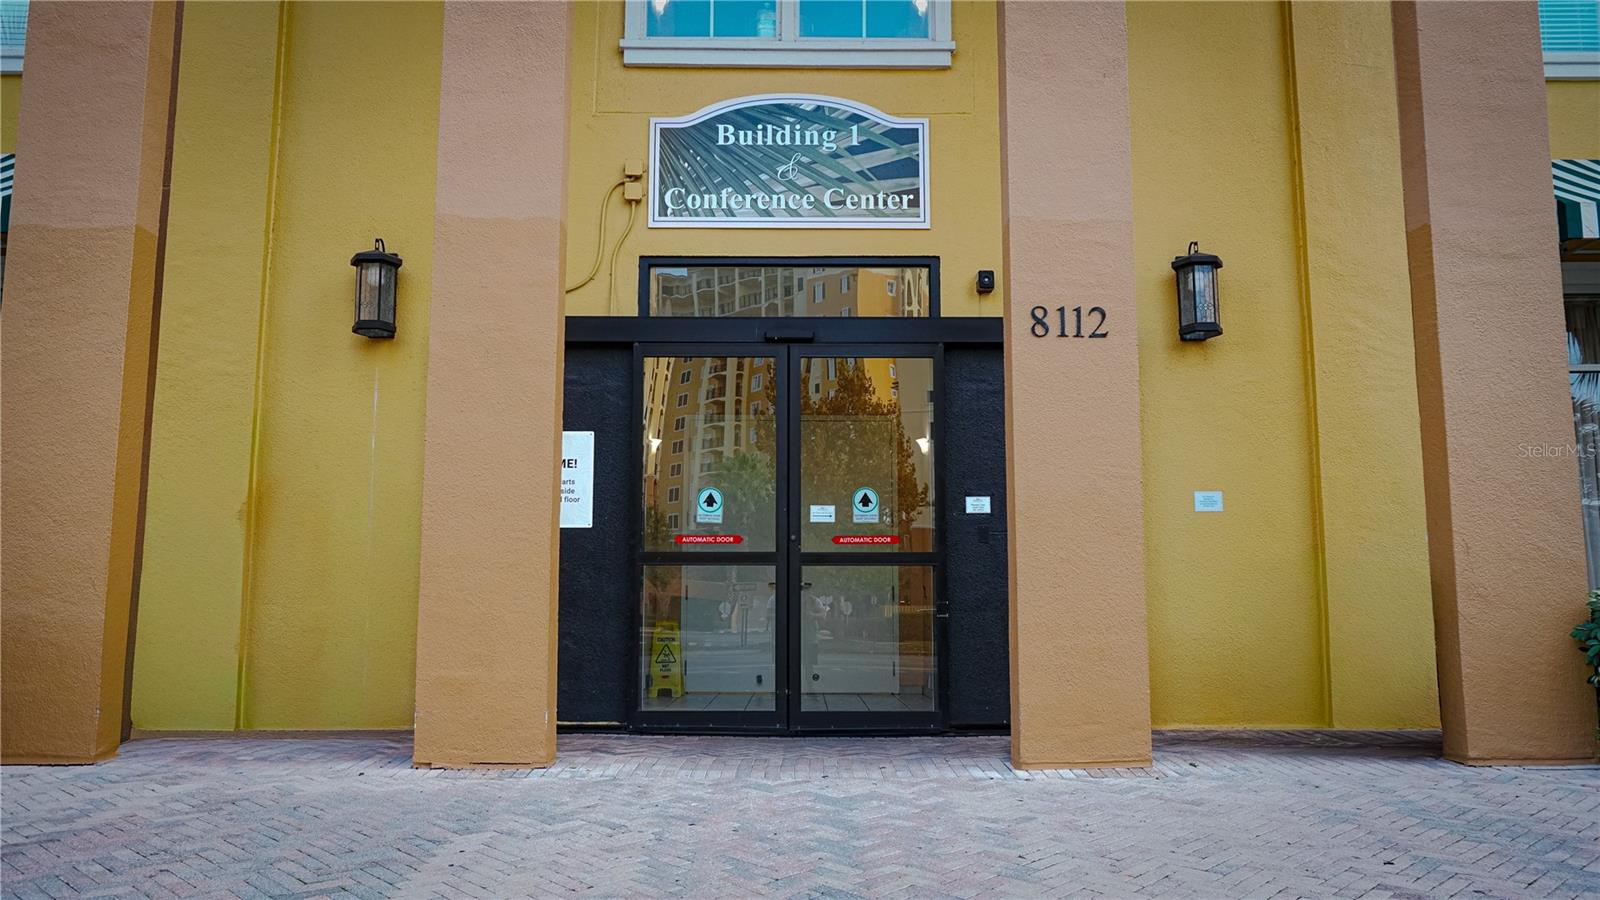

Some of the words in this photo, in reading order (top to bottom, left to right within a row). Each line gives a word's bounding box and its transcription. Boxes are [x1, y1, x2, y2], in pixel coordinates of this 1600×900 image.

[716, 124, 837, 151] Building
[850, 125, 860, 146] 1
[777, 152, 801, 181] &
[664, 187, 815, 210] Conference
[824, 187, 914, 210] Center
[1030, 305, 1109, 338] 8112
